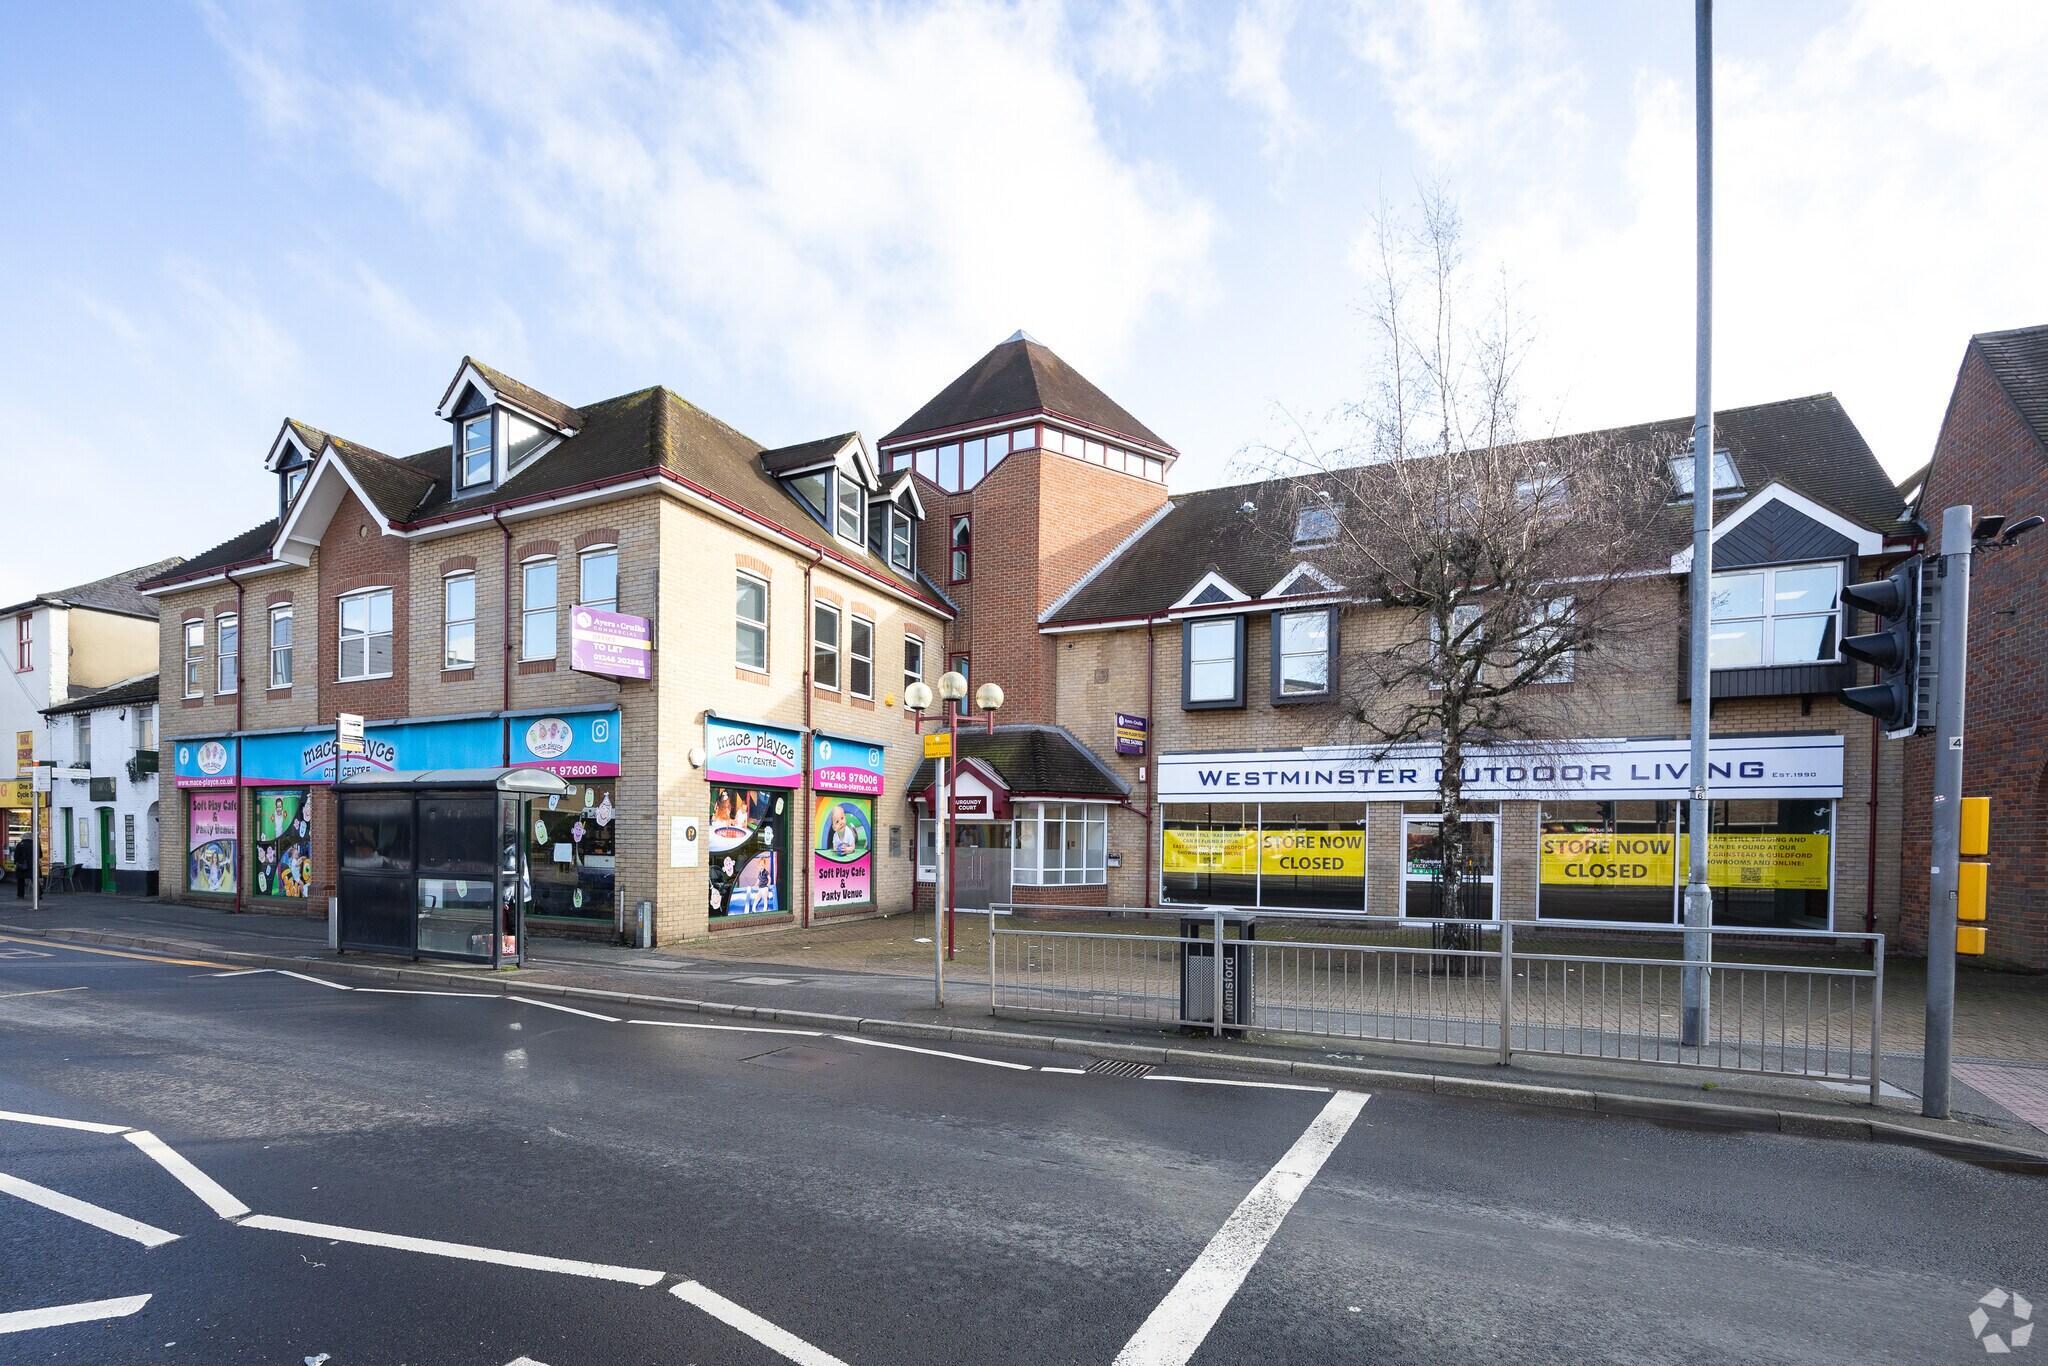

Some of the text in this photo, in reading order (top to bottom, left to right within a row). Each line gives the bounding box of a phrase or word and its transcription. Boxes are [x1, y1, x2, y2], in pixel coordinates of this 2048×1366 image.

[594, 618, 615, 627] Ayers
[593, 626, 636, 637] COMMERCIAL
[608, 645, 623, 653] LET
[717, 731, 794, 760] mace playce
[1953, 738, 1961, 747] 4
[737, 755, 776, 767] CITY CENTRE
[324, 767, 336, 777] CIT
[560, 765, 598, 776] 976006
[1198, 770, 1418, 785] WESTMINSTER
[1631, 762, 1764, 780] LIVNG
[820, 770, 878, 784] 01245 976006
[820, 782, 878, 792] www.mace-playce.co.uk
[193, 800, 206, 811] Soft
[208, 800, 221, 812] Play
[212, 812, 217, 822] &
[196, 824, 235, 835] Party Venue
[1264, 836, 1362, 849] STORE NOW
[1544, 840, 1670, 854] STORE NOW
[1280, 856, 1344, 870] CLOSED
[819, 867, 865, 879] Soft Play Cafe
[1564, 864, 1648, 878] CLOSED
[840, 879, 845, 888] &
[822, 890, 862, 901] Party Venue
[1223, 958, 1234, 1020] helmsford
